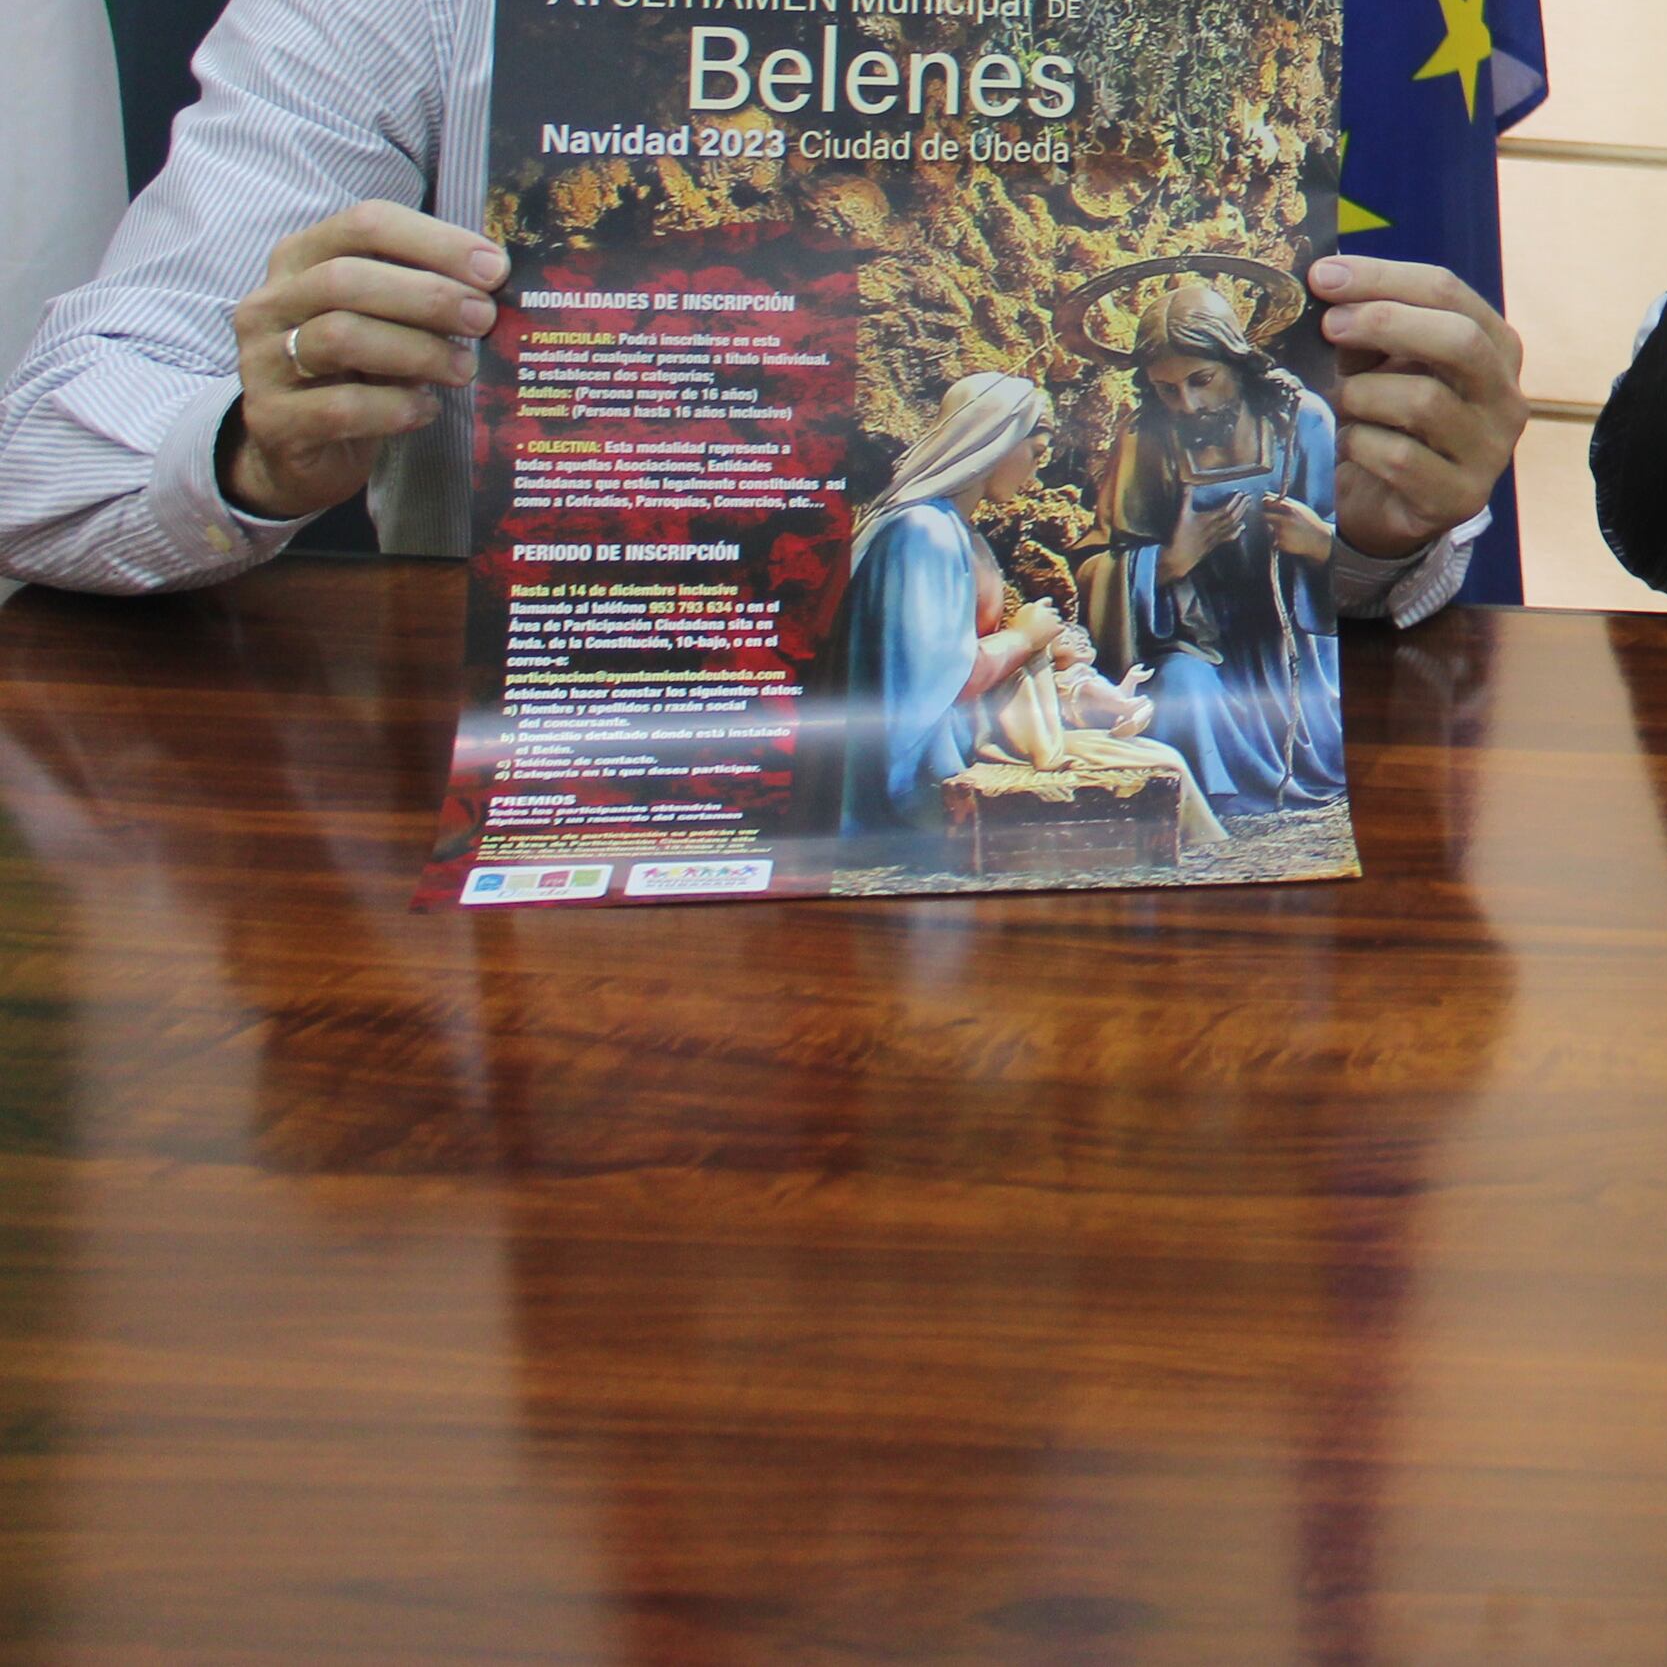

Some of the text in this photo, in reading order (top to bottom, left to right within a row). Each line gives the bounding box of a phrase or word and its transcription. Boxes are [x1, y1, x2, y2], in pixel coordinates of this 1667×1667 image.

[689, 25, 1076, 118] Belenes
[542, 123, 689, 156] Navidad
[700, 126, 786, 157] 2023
[800, 129, 910, 160] Ciudad
[921, 131, 958, 162] de
[522, 292, 794, 312] MODALIDADES DE INSCRIPCIÓN
[513, 541, 739, 561] PERIODO DE INSCRIPCIÓN
[511, 584, 738, 597] Hasta el 14 de diciembre inclusive
[490, 795, 577, 807] PREMIOS
